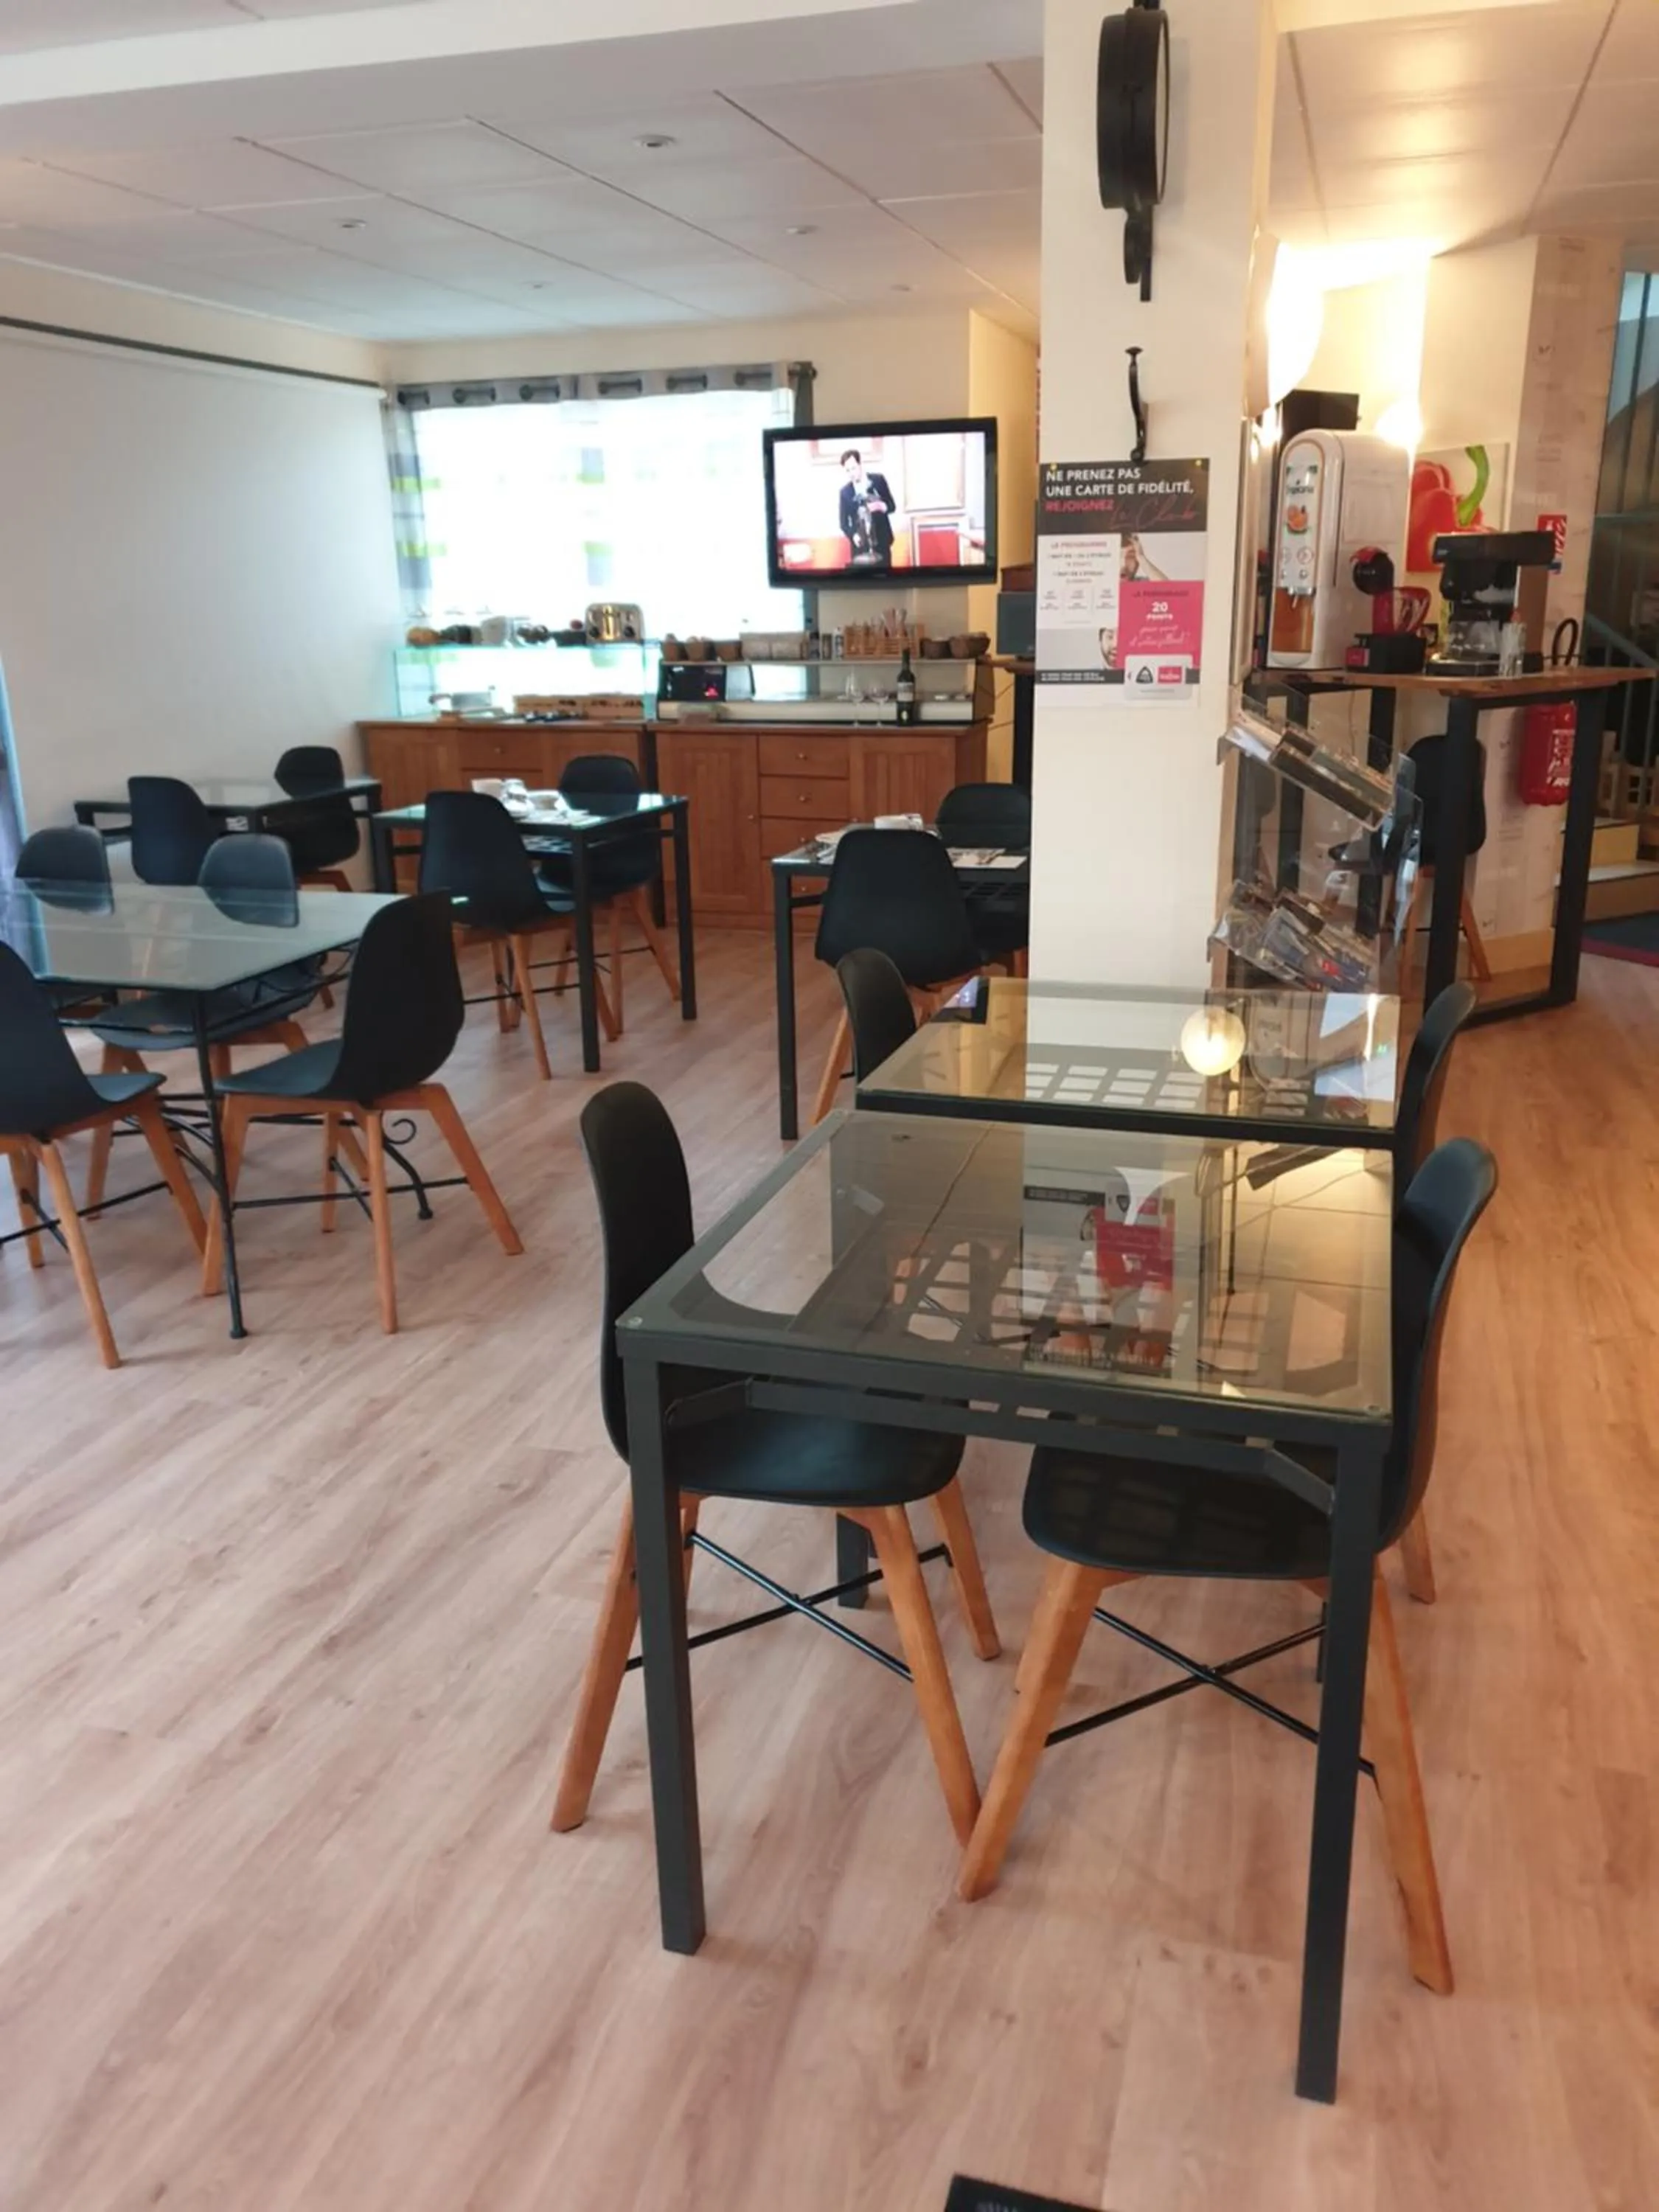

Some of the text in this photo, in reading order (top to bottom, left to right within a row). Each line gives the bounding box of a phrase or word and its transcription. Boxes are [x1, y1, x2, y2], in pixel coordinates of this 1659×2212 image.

[1046, 467, 1141, 482] NE PRENEZ PAS
[1046, 485, 1072, 496] UNE
[1075, 484, 1114, 496] CARTE
[1118, 483, 1135, 495] DE
[1045, 498, 1115, 512] REJOIGNEZ
[1151, 601, 1169, 613] 20
